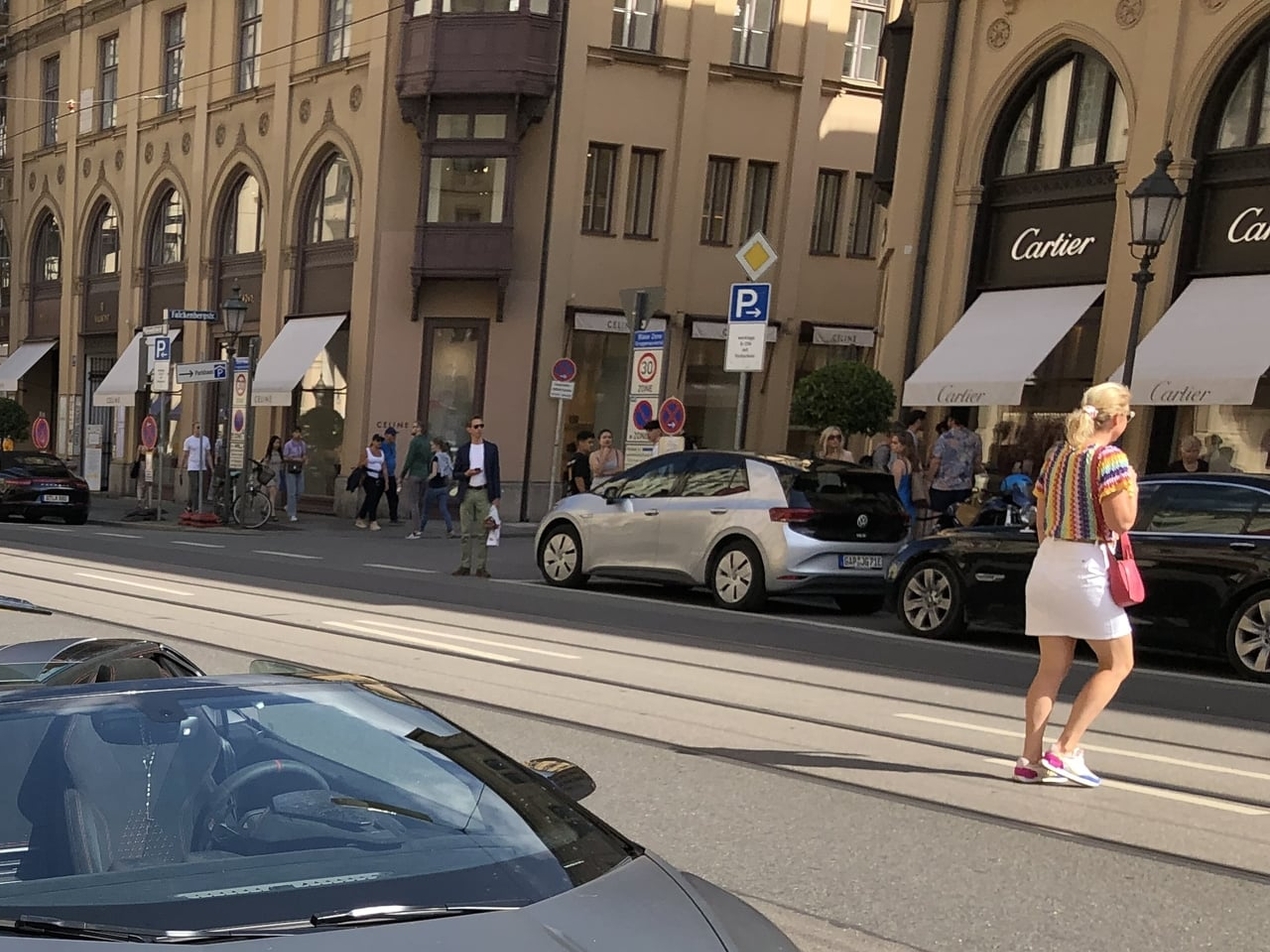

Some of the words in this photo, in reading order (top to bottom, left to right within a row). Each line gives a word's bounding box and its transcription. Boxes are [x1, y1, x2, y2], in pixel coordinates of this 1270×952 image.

[1010, 227, 1096, 261] Cartier
[735, 288, 758, 318] P
[156, 339, 167, 358] P
[640, 360, 653, 375] 30
[936, 384, 987, 404] Cartier
[1149, 380, 1211, 403] Cartier
[377, 421, 409, 429] CELINE
